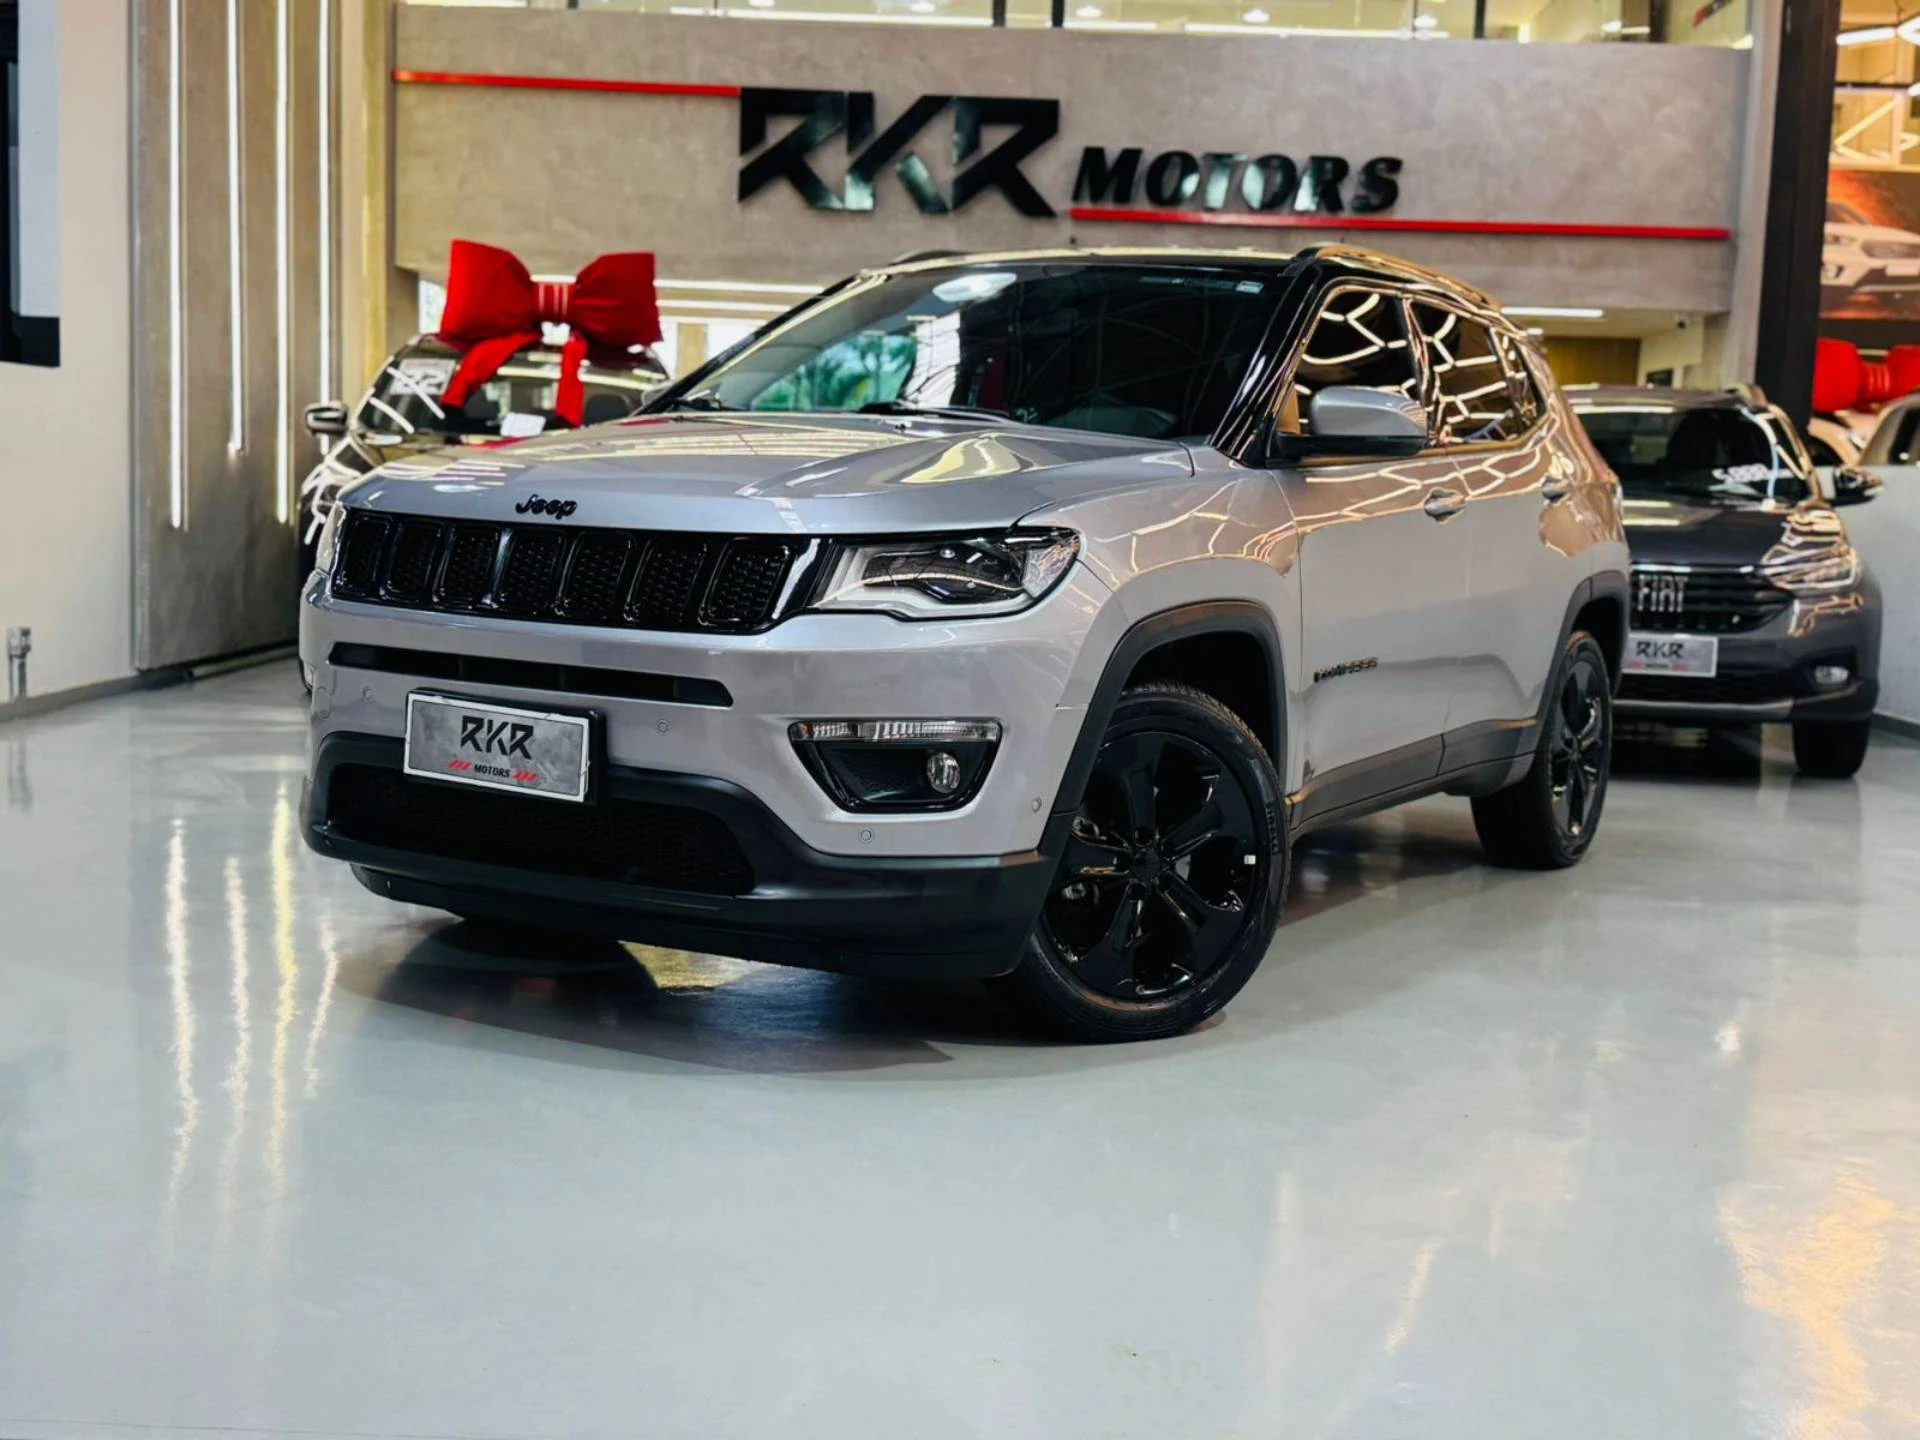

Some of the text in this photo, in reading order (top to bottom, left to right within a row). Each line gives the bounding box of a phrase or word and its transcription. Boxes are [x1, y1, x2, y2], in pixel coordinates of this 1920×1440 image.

[738, 87, 1404, 218] RKR MOTORS
[515, 494, 577, 520] Jeep
[1636, 641, 1684, 659] RKR
[460, 715, 534, 760] RKR
[474, 764, 510, 778] MOTORS
